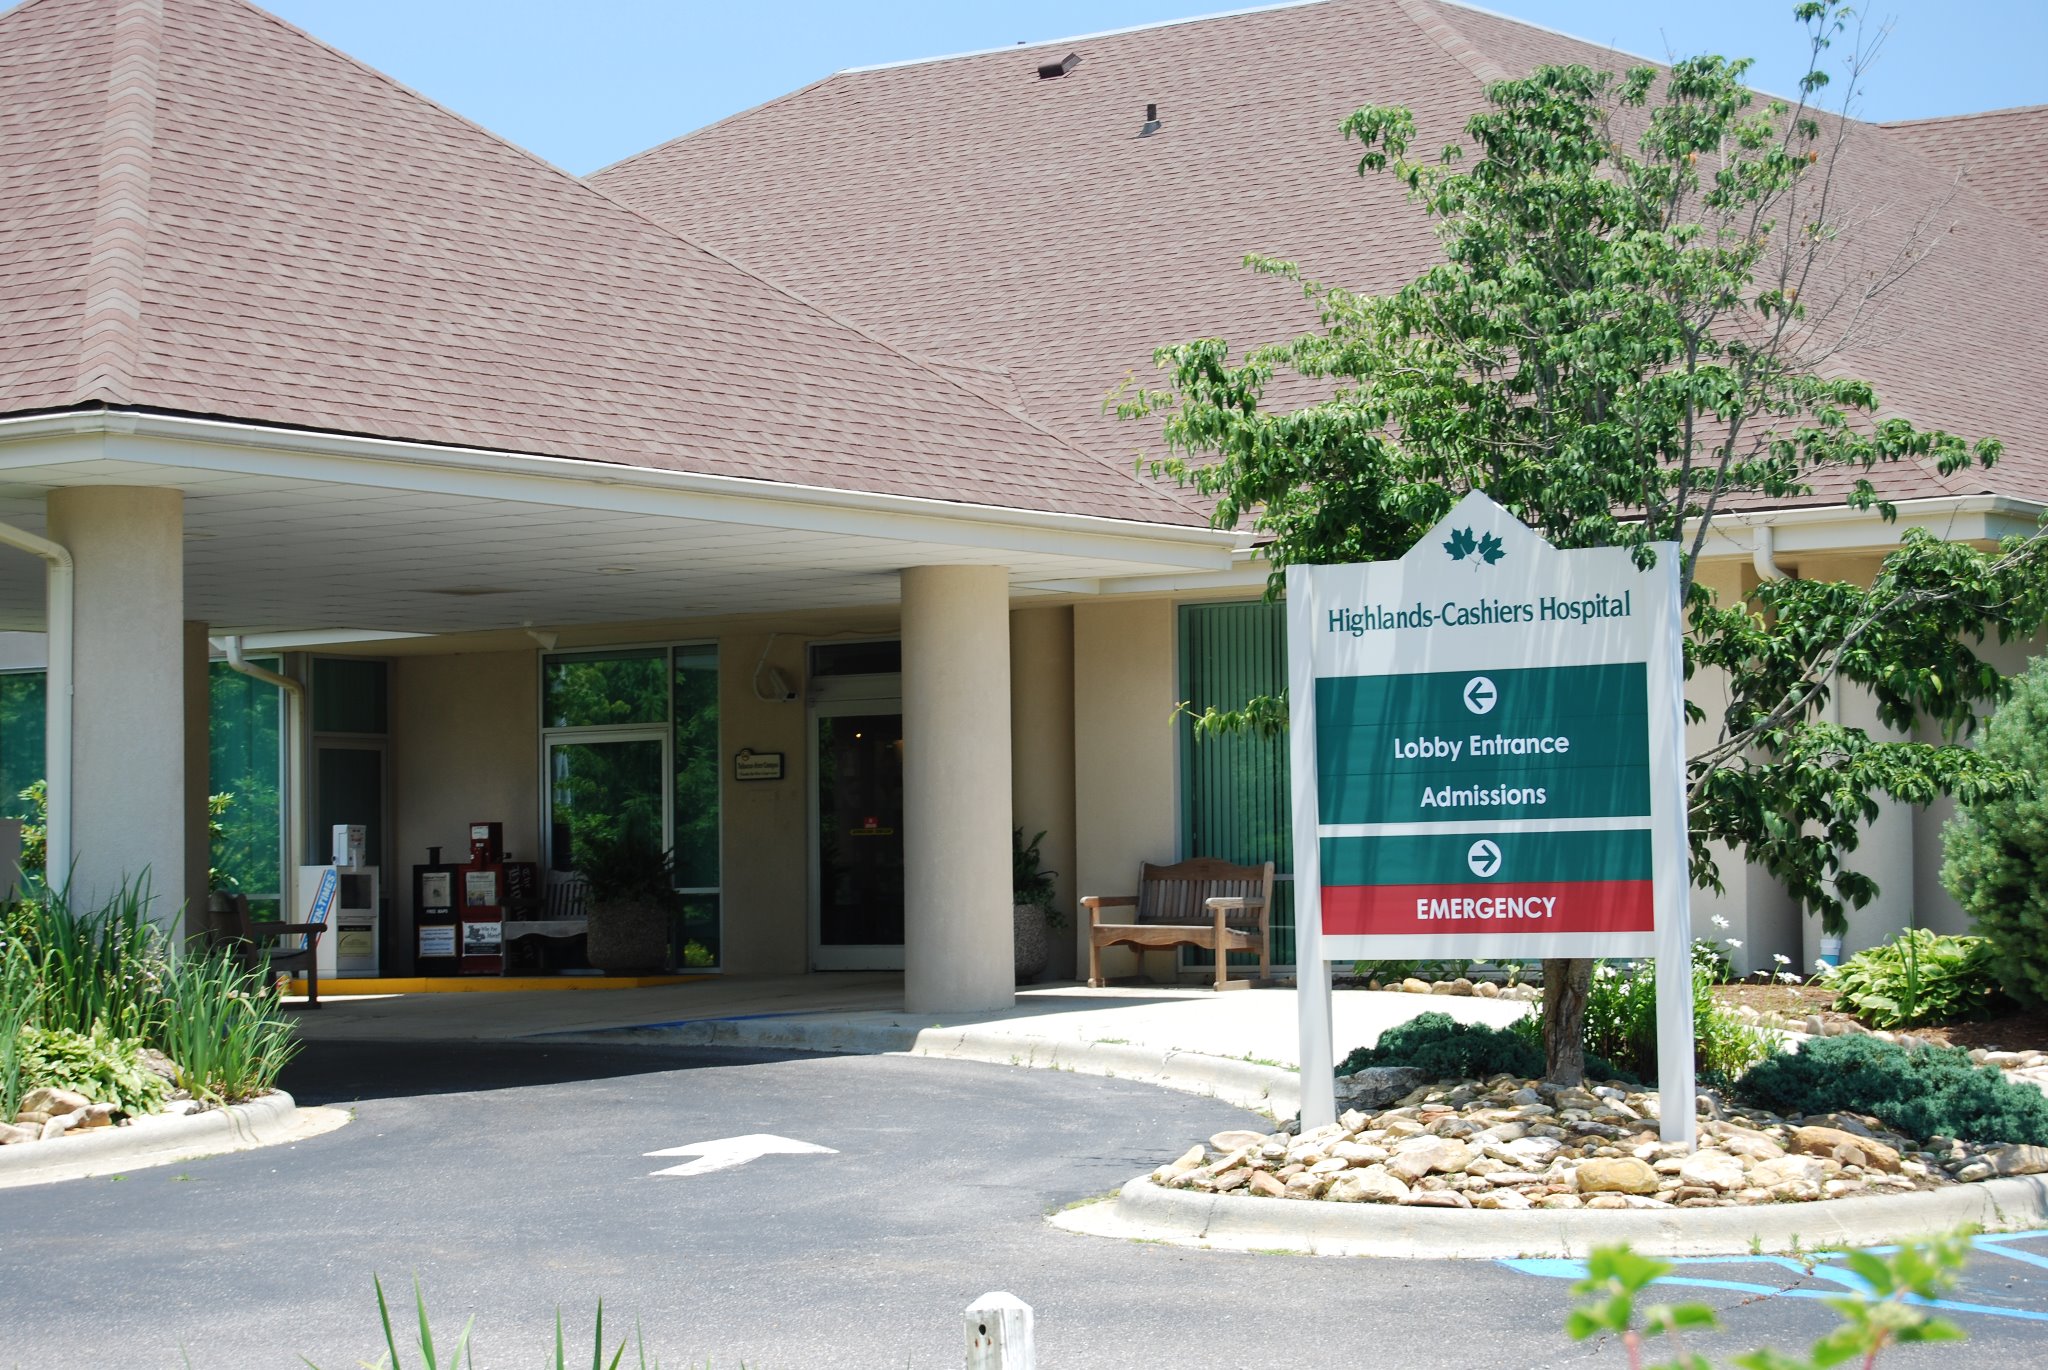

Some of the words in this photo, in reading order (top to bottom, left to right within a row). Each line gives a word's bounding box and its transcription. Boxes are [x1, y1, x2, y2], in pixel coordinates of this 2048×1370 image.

[1328, 598, 1533, 637] Highlands-Cashiers
[1539, 589, 1631, 624] Hospital
[1394, 736, 1463, 762] Lobby
[1469, 734, 1570, 756] Entrance
[1420, 783, 1547, 807] Admissions
[1417, 896, 1556, 920] EMERGENCY
